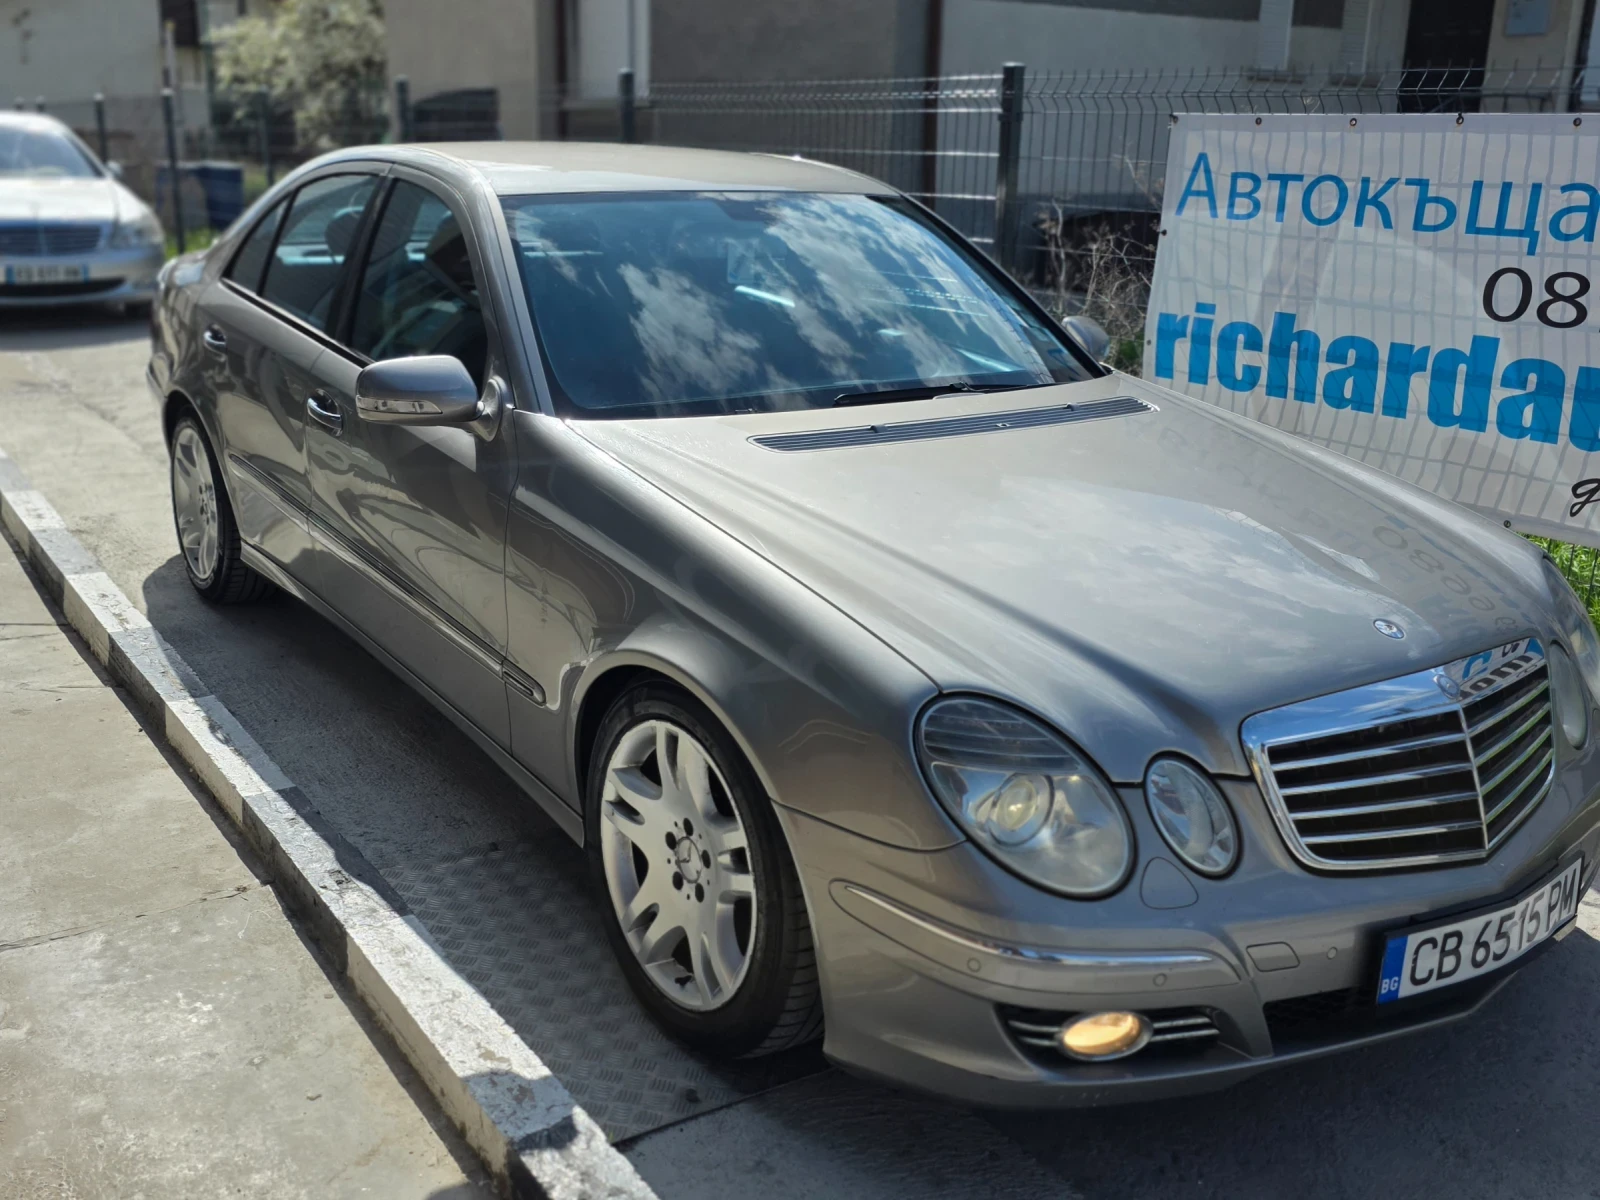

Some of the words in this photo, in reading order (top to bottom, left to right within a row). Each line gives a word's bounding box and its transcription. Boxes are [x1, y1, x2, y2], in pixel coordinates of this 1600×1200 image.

[1175, 152, 1600, 256] Автокъща
[1482, 267, 1600, 333] 08
[1409, 930, 1464, 986] CB
[1471, 893, 1545, 969] 6515
[1545, 868, 1577, 933] PM
[1381, 976, 1399, 994] BG
